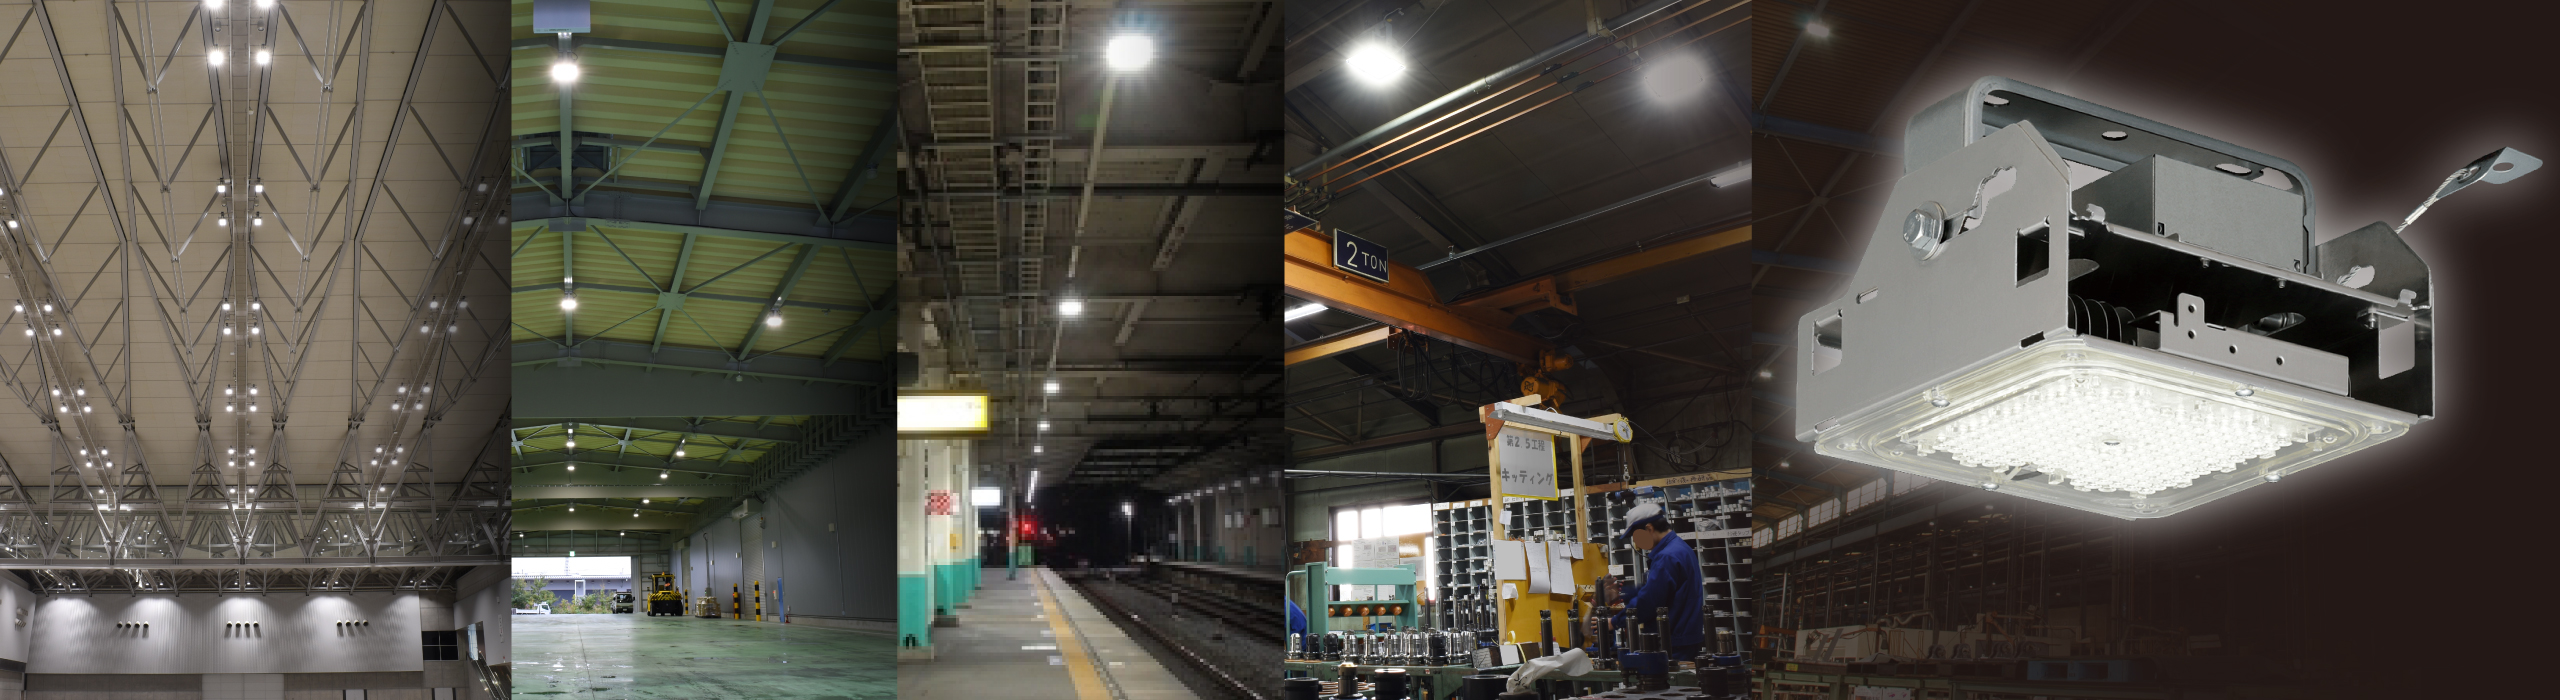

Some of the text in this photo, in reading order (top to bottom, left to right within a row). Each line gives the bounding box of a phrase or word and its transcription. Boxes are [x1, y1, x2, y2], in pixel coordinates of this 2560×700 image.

[1346, 240, 1387, 273] 2 TON
[1501, 467, 1554, 486] キッティング
